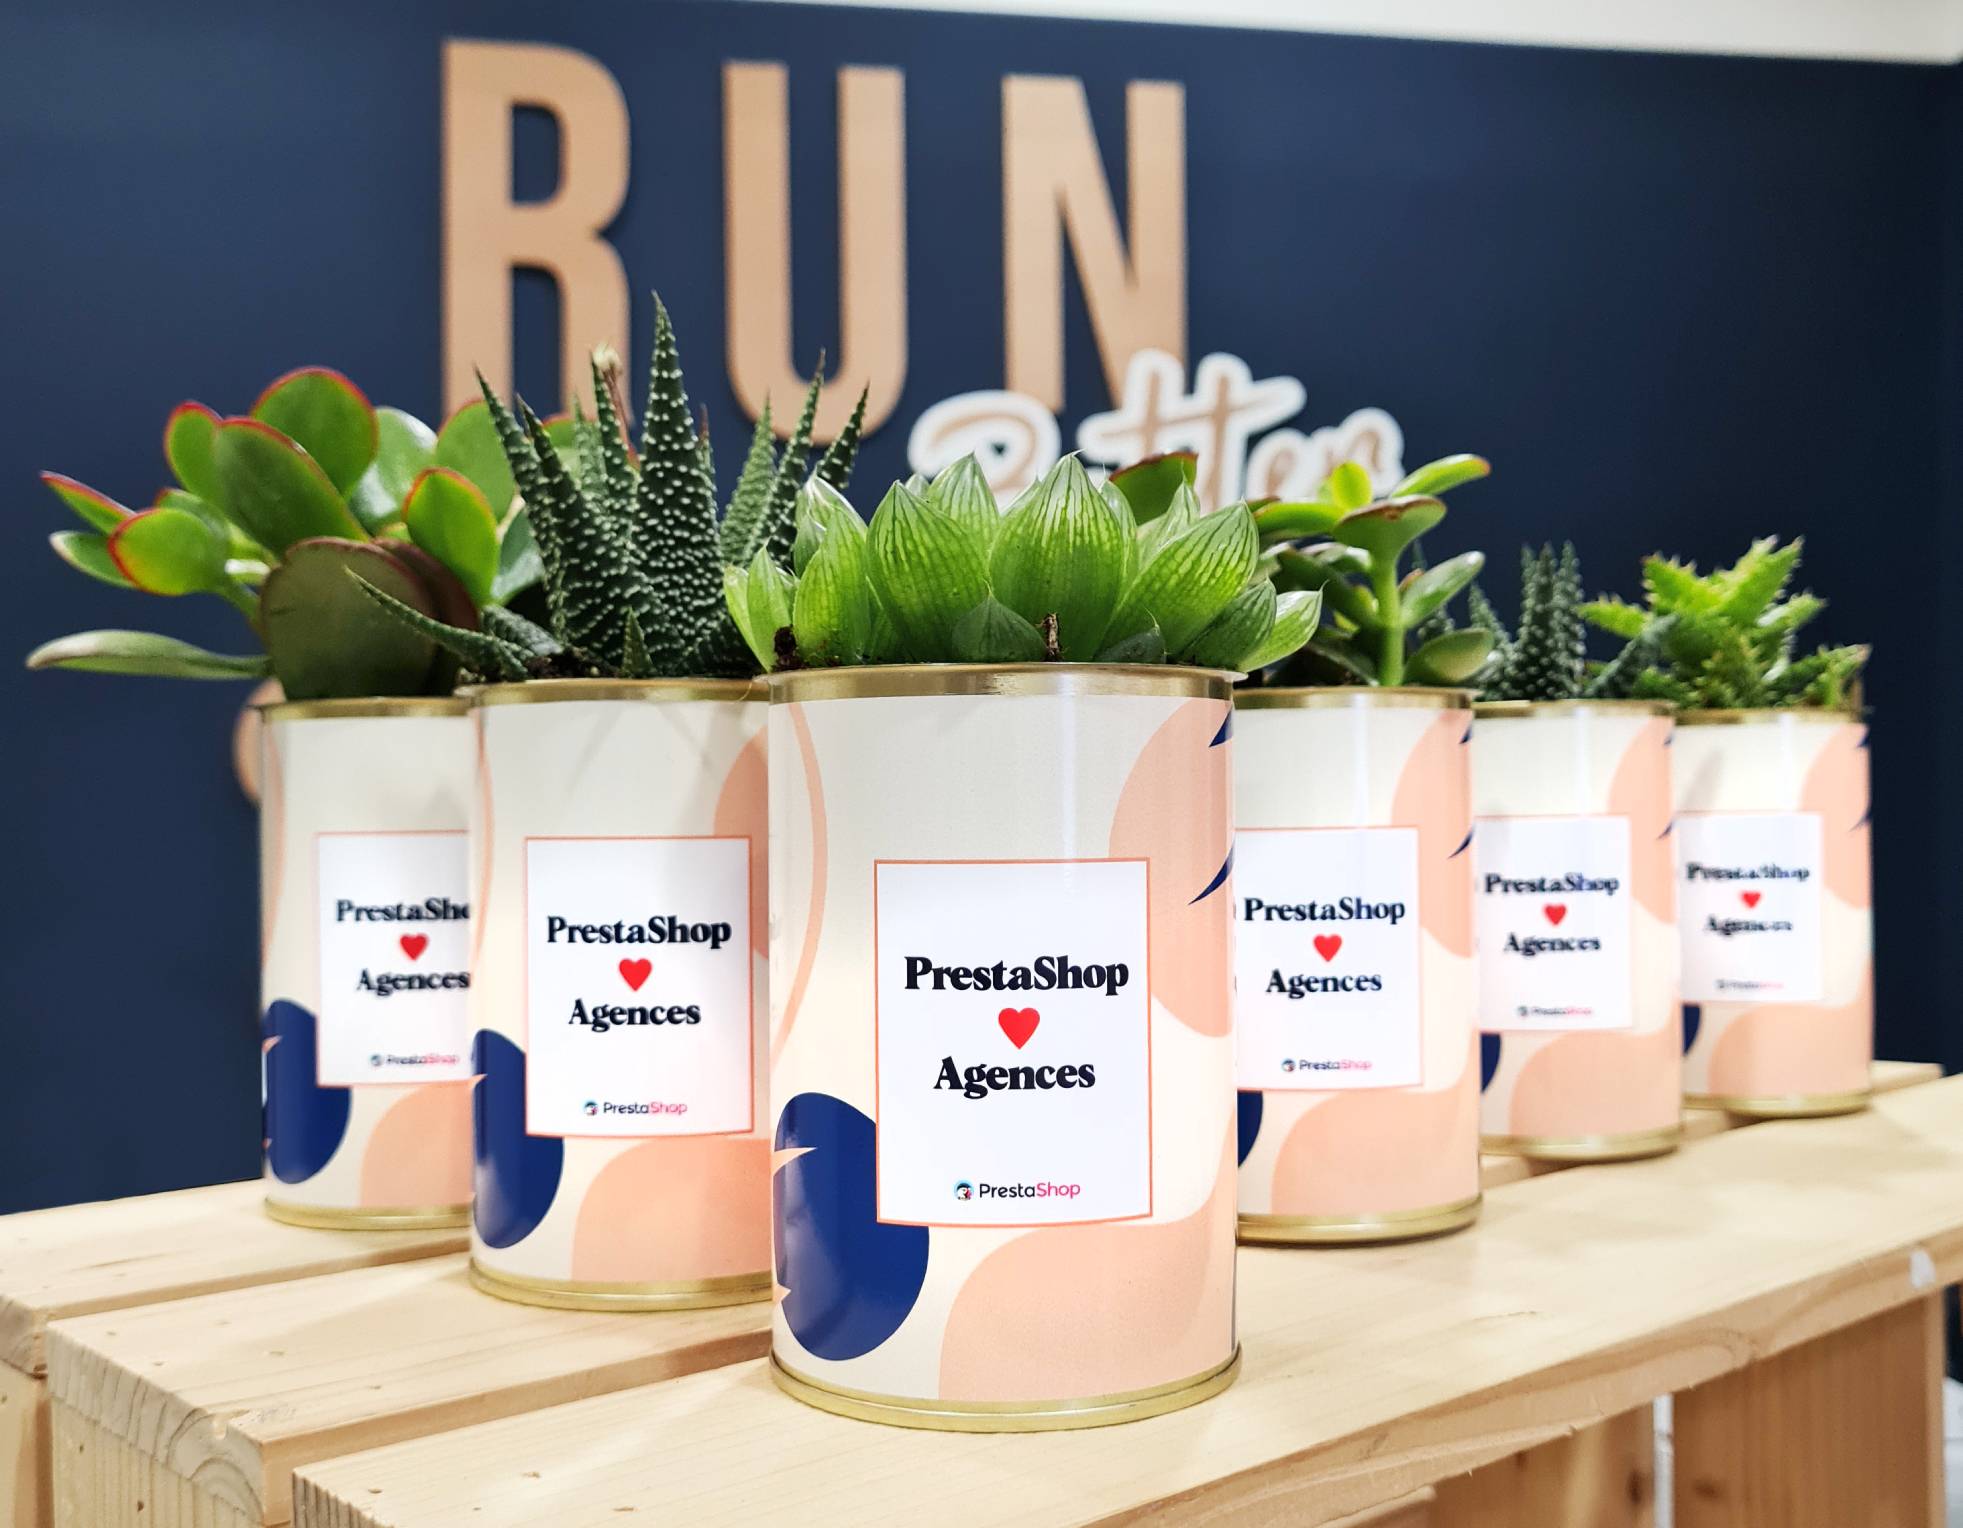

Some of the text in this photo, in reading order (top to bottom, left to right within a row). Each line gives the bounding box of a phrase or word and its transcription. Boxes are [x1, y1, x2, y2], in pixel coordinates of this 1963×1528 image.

[441, 38, 1187, 446] RUN
[1484, 872, 1620, 896] PrestaShop
[1243, 896, 1406, 924] PrestaShop
[547, 915, 732, 949] PrestaShop
[1503, 932, 1601, 956] Agences
[357, 969, 470, 996] Agences
[904, 955, 1129, 996] PrestaShop
[1265, 968, 1382, 999] Agences
[568, 998, 701, 1033] Agences
[933, 1055, 1096, 1100] Agences
[1299, 1059, 1372, 1071] PrestaShop
[602, 1101, 688, 1116] PrestaShop
[979, 1182, 1081, 1200] PrestaShop
